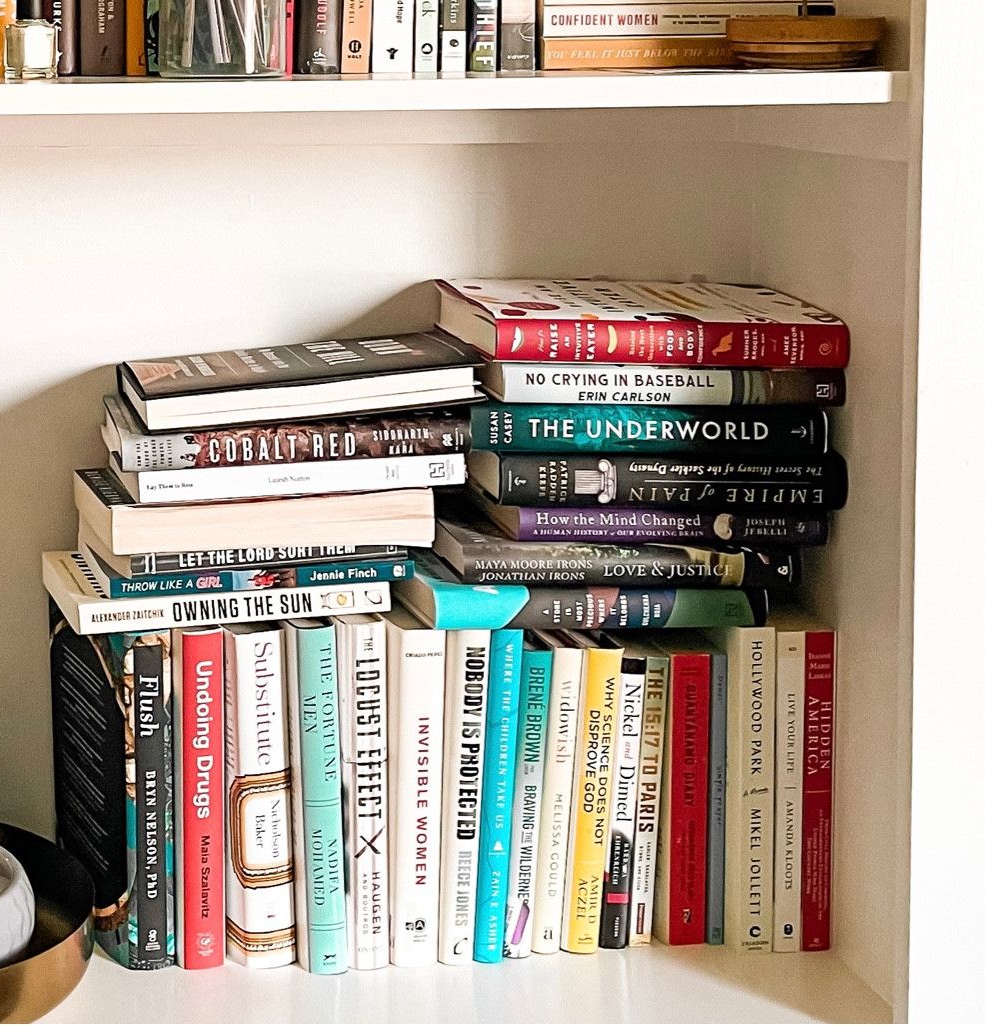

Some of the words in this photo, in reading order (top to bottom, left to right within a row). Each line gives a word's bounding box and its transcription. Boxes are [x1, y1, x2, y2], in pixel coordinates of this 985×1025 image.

[525, 373, 545, 386] NO
[552, 373, 608, 386] CRYING
[615, 374, 628, 386] IN
[634, 374, 714, 387] BASEBALL
[578, 390, 607, 402] ERIN
[610, 391, 671, 402] CARLSON
[209, 435, 297, 463] COBALT
[313, 432, 356, 458] RED
[528, 419, 574, 438] THE
[587, 420, 769, 440] UNDERWORLD
[309, 569, 344, 581] Jennie
[348, 567, 377, 579] Finch
[91, 610, 131, 622] ALEXANDER
[133, 608, 164, 620] ZAITCHIK
[173, 598, 238, 623] OWNING
[244, 596, 273, 617] THE
[280, 593, 312, 615] SUN
[138, 675, 159, 737] Flush
[193, 661, 213, 749] Undoing
[254, 642, 274, 766] Substitute
[750, 641, 762, 733] HOLLYWOOD
[417, 718, 429, 808] INVISIBLE
[750, 741, 762, 775] PARK
[192, 755, 213, 819] Drugs
[750, 808, 761, 848] MIKEL
[416, 816, 428, 885] WOMEN
[750, 853, 761, 916] JOLLETT
